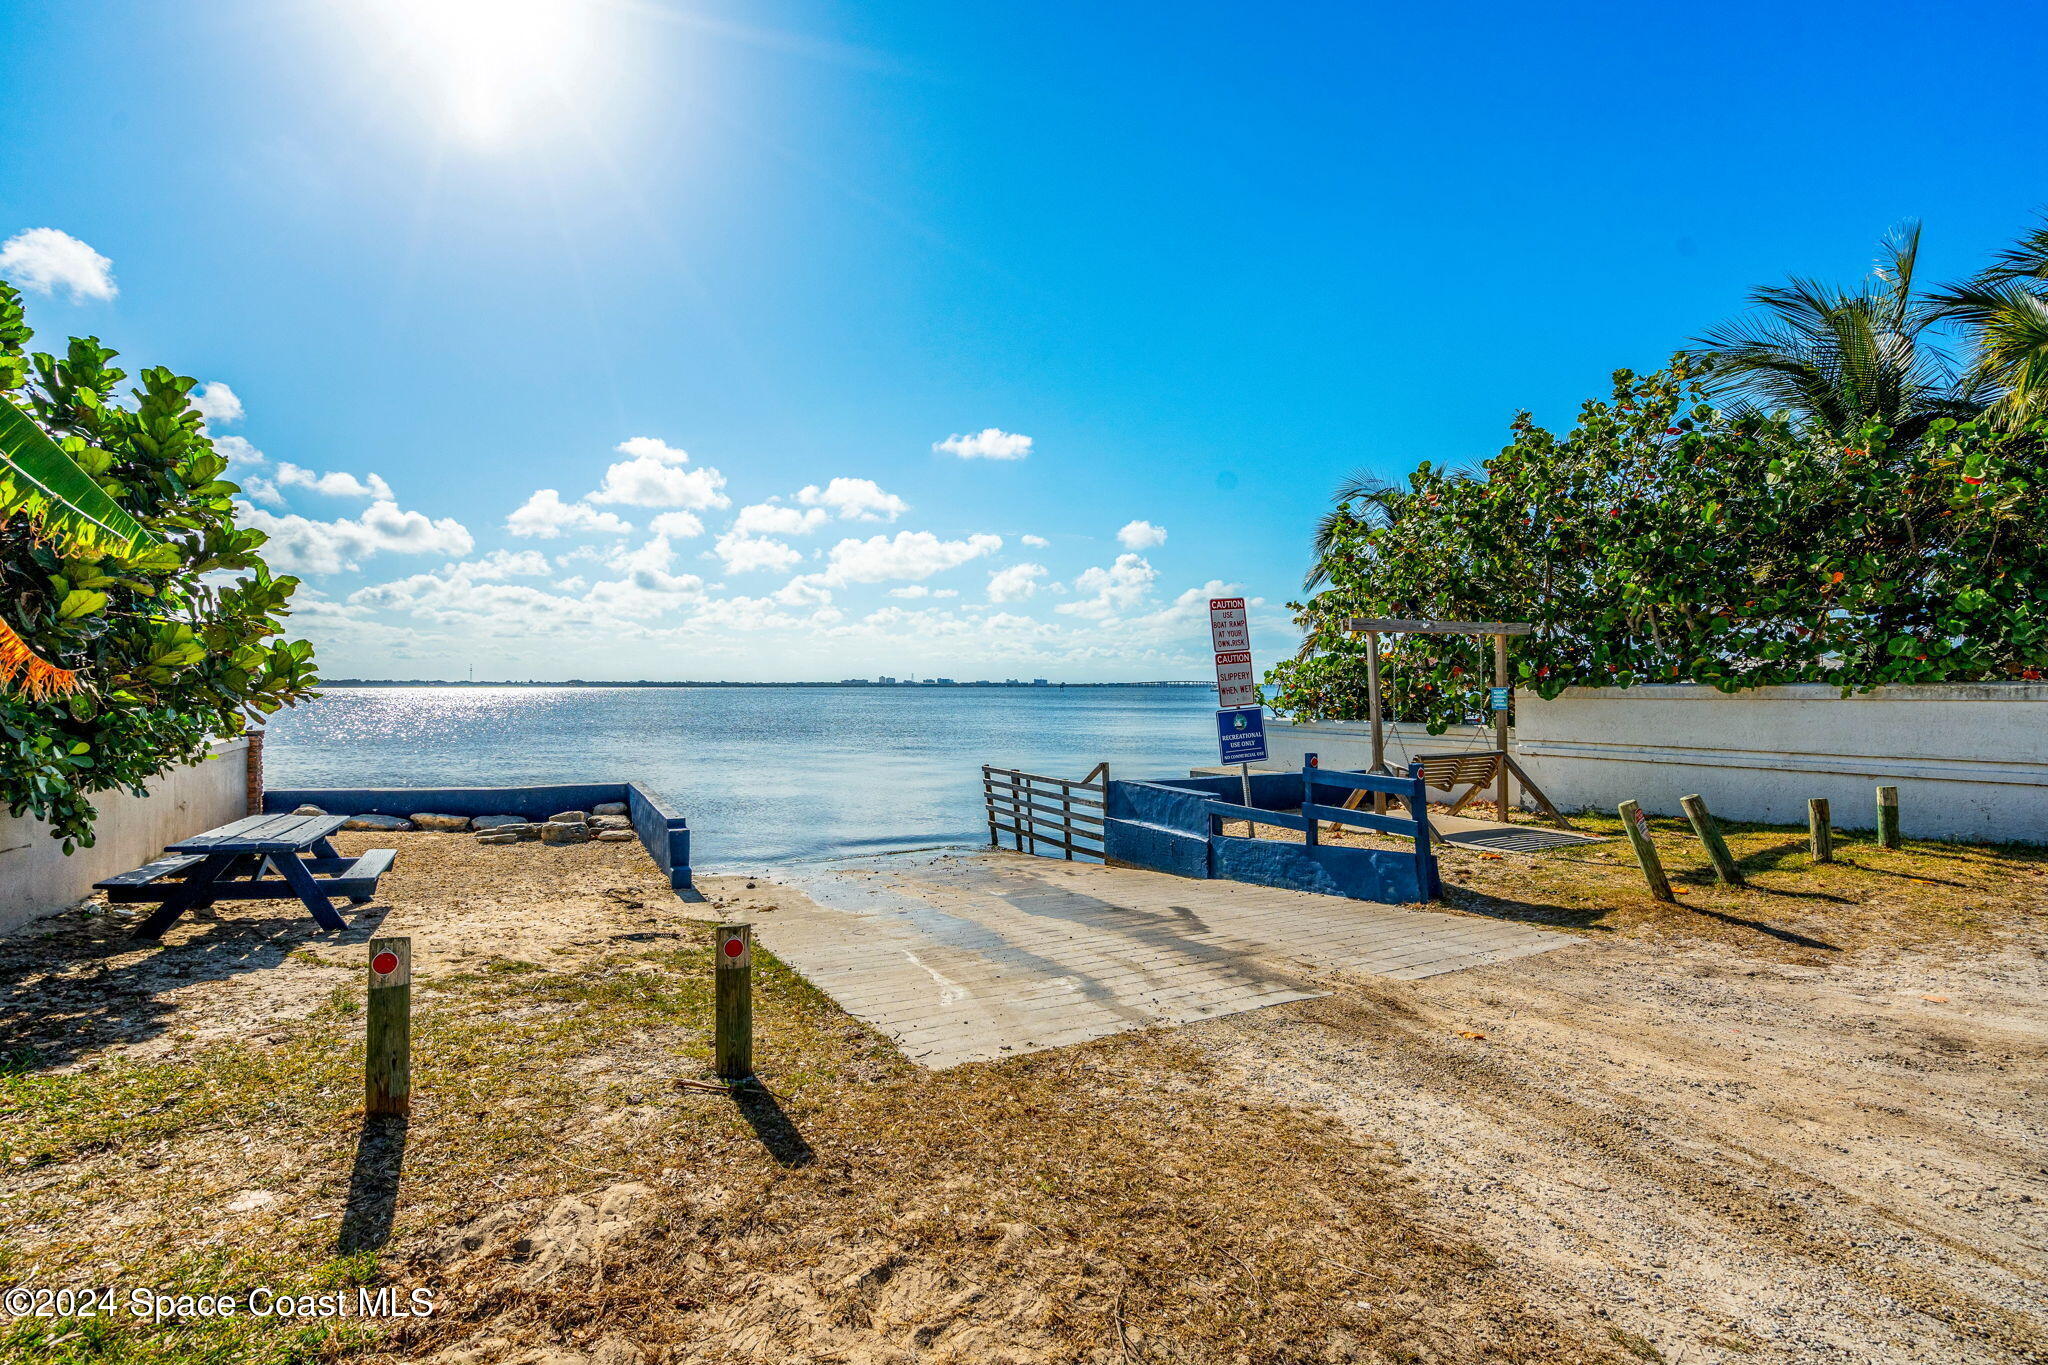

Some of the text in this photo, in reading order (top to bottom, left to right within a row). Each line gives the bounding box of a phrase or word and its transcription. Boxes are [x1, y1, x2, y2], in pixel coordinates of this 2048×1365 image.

[1212, 600, 1244, 609] CAUTION
[1217, 654, 1250, 664] CAUTION
[1220, 672, 1250, 682] SLIPPERY
[1220, 685, 1252, 695] WHEN WET
[1222, 732, 1262, 741] RECREATIONAL
